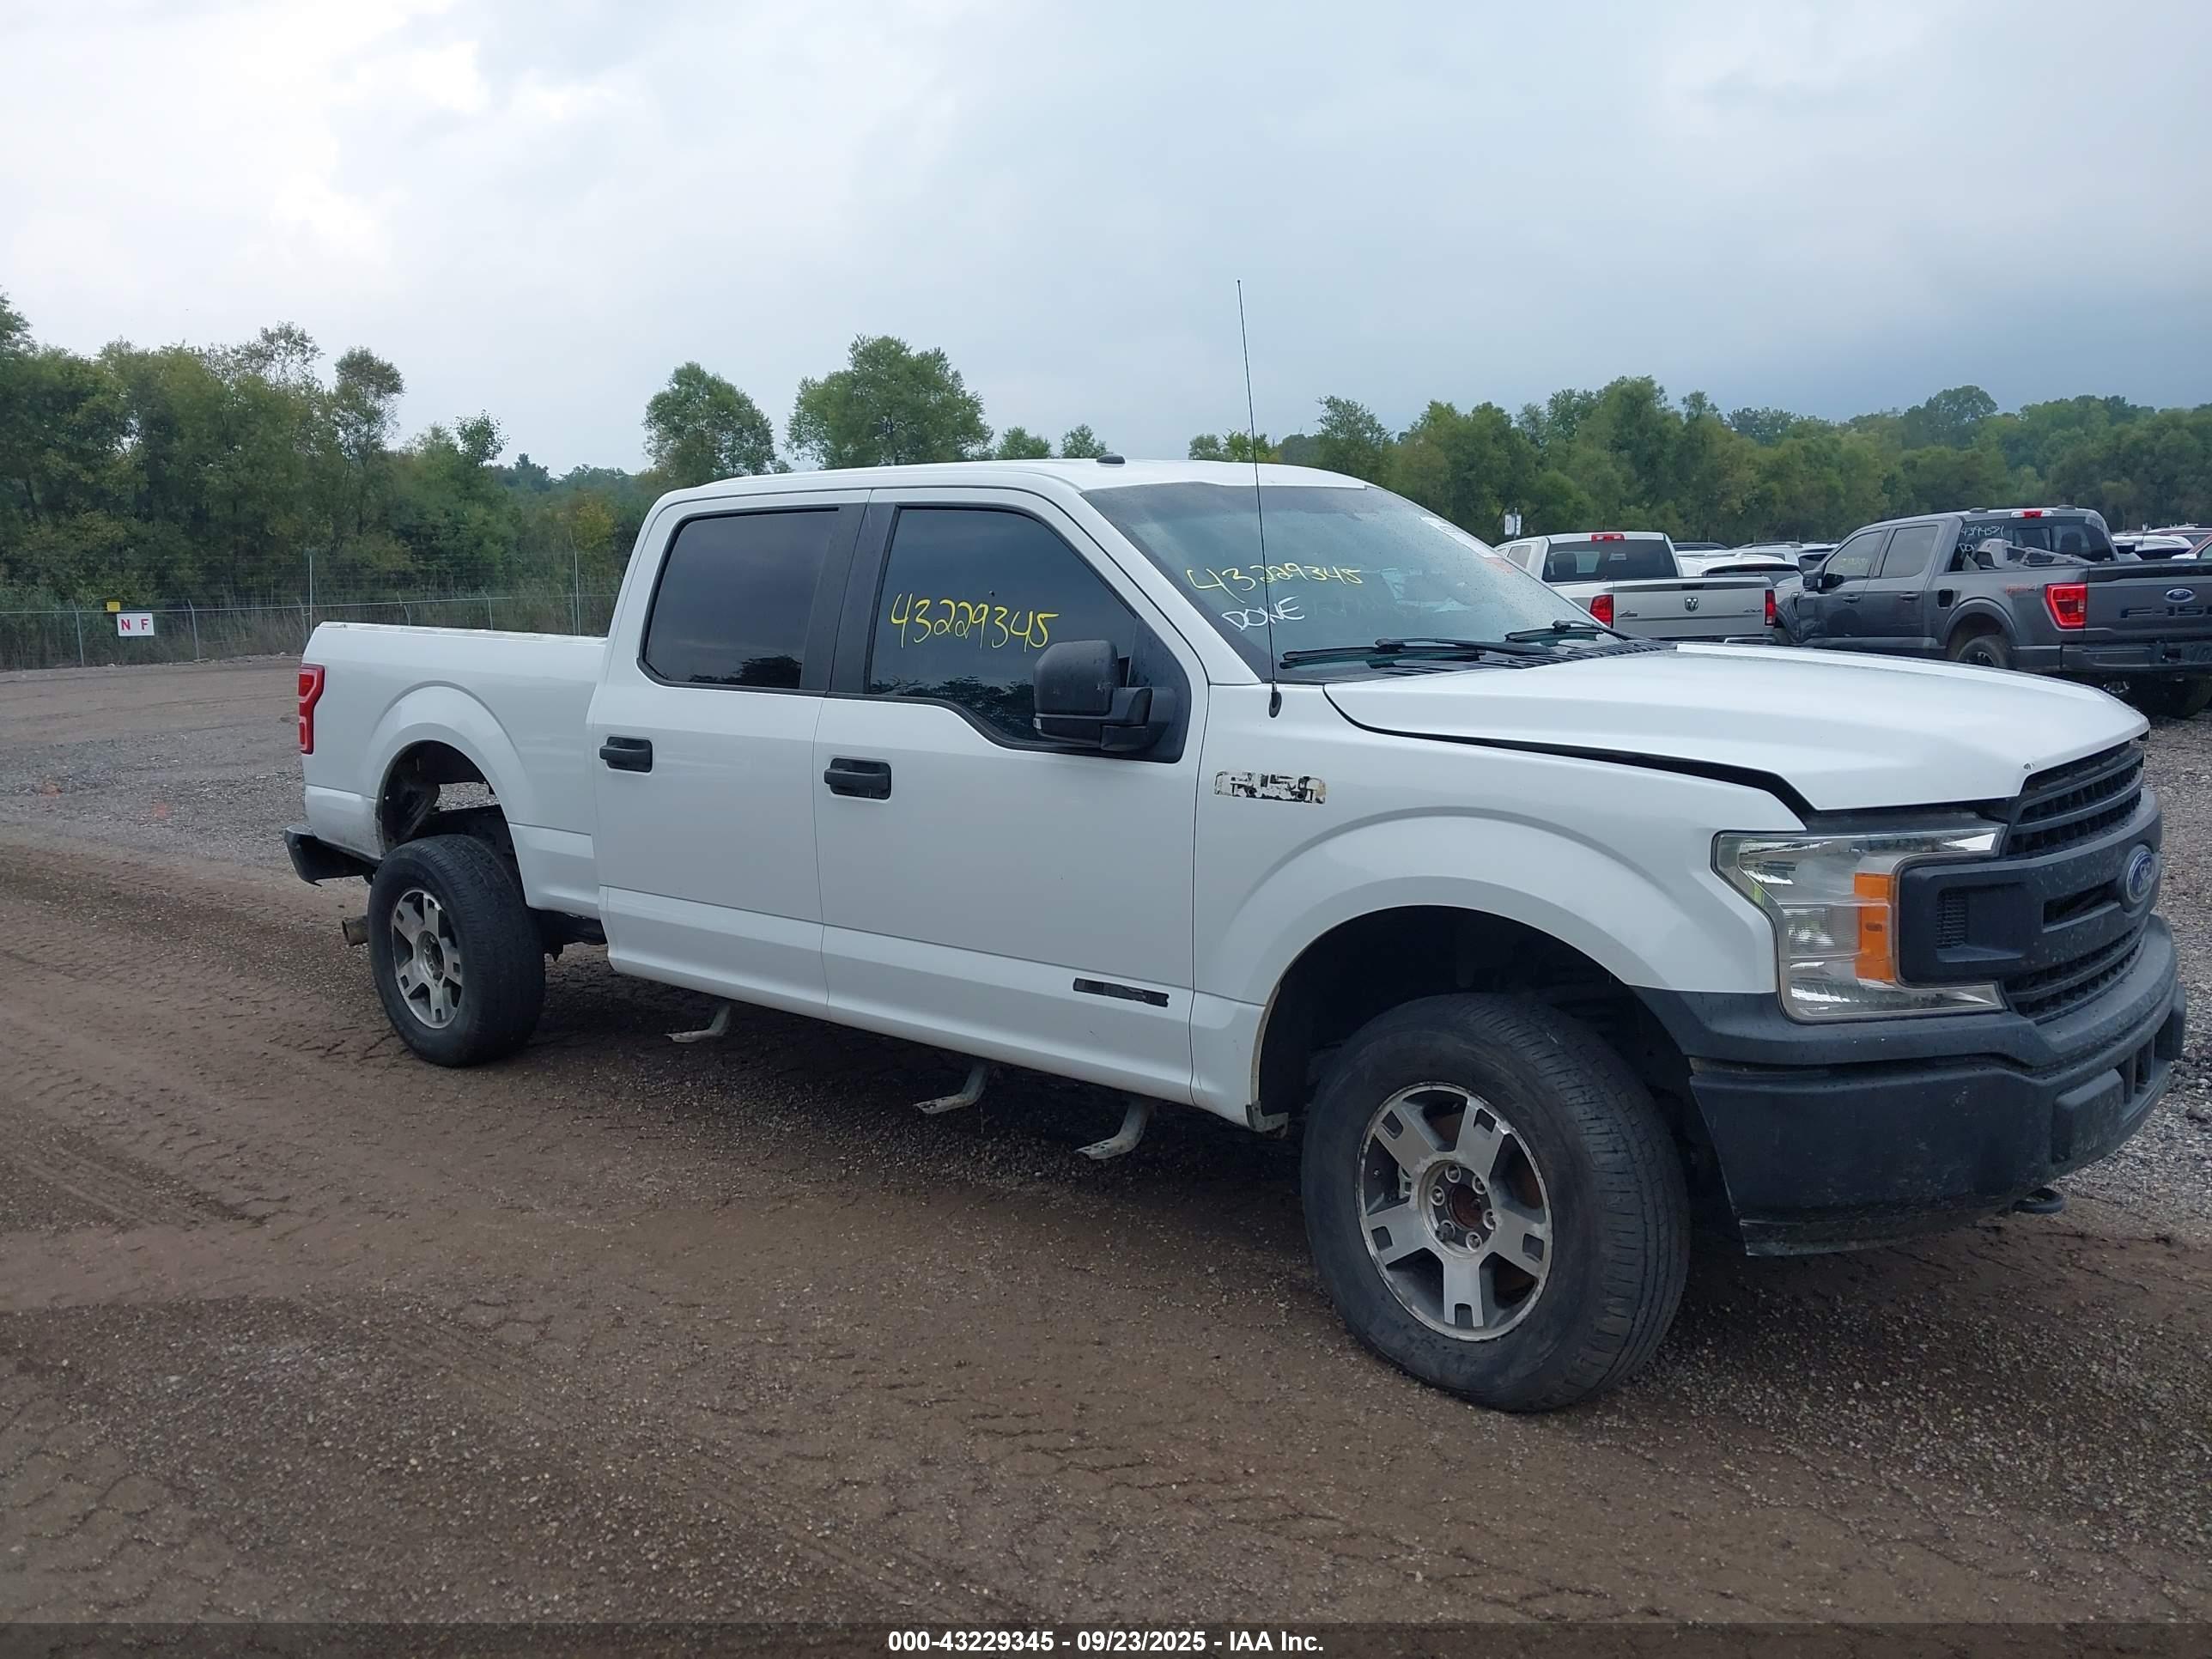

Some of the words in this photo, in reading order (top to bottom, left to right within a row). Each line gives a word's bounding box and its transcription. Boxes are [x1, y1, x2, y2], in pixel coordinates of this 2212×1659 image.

[1186, 562, 1364, 604] 43229345
[121, 619, 131, 630] N
[141, 619, 149, 630] F
[890, 592, 1060, 653] 43229345
[1221, 596, 1305, 632] DONE
[2120, 605, 2212, 619] F-15
